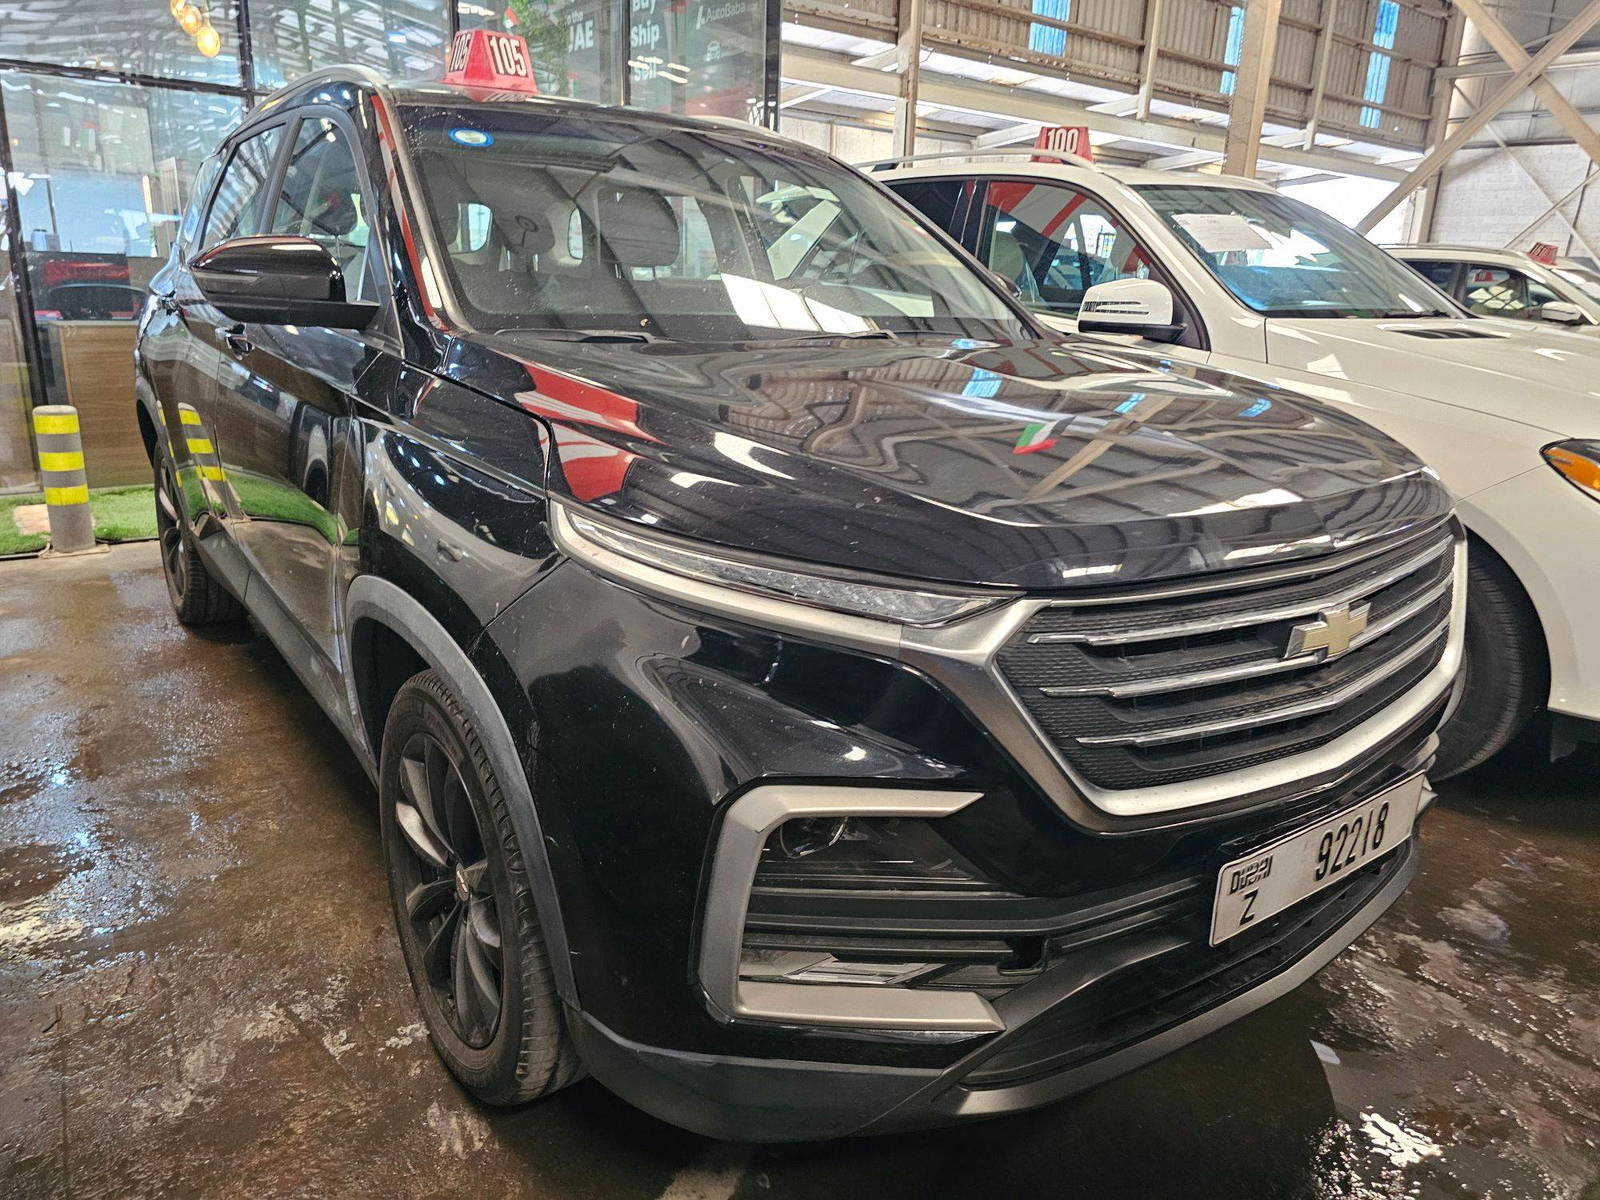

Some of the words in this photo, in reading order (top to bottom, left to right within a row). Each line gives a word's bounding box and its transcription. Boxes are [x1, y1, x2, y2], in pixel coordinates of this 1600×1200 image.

[450, 33, 471, 71] 105
[490, 35, 527, 76] 105
[1047, 128, 1079, 154] 100
[1315, 801, 1389, 881] 92218
[1239, 889, 1259, 926] Z
